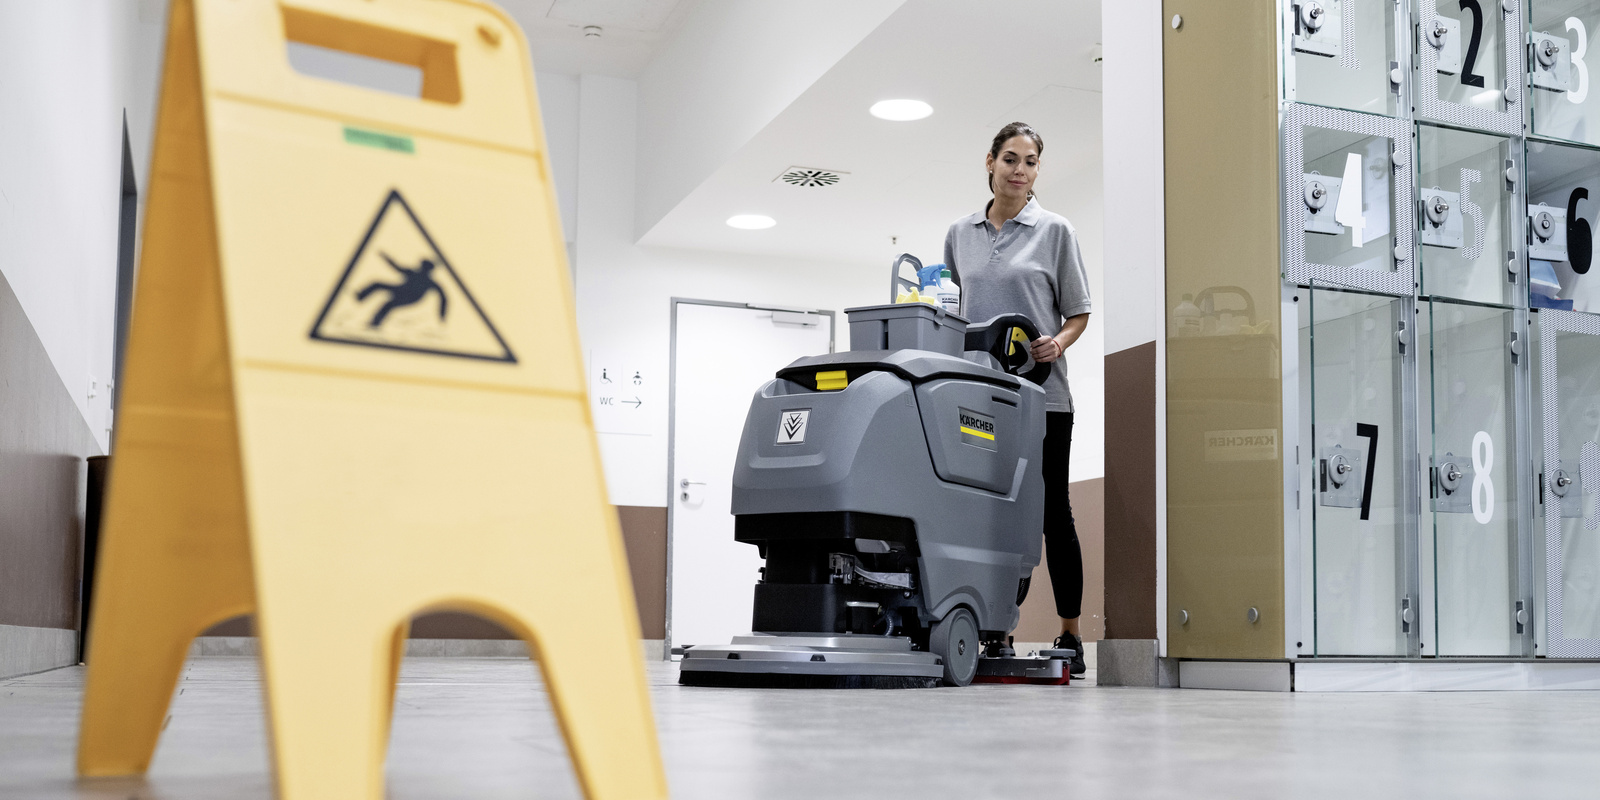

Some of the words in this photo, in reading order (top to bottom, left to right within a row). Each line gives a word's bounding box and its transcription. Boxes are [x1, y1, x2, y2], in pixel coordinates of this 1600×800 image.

[1460, 0, 1484, 88] 2
[1565, 16, 1589, 104] 3
[1335, 152, 1366, 248] 4
[1460, 167, 1485, 261] 5
[1566, 187, 1592, 274] 6
[599, 396, 614, 405] WC
[959, 413, 995, 433] KÄRCHER
[1356, 422, 1378, 520] 7
[1471, 430, 1495, 524] 8
[1579, 440, 1600, 530] 9
